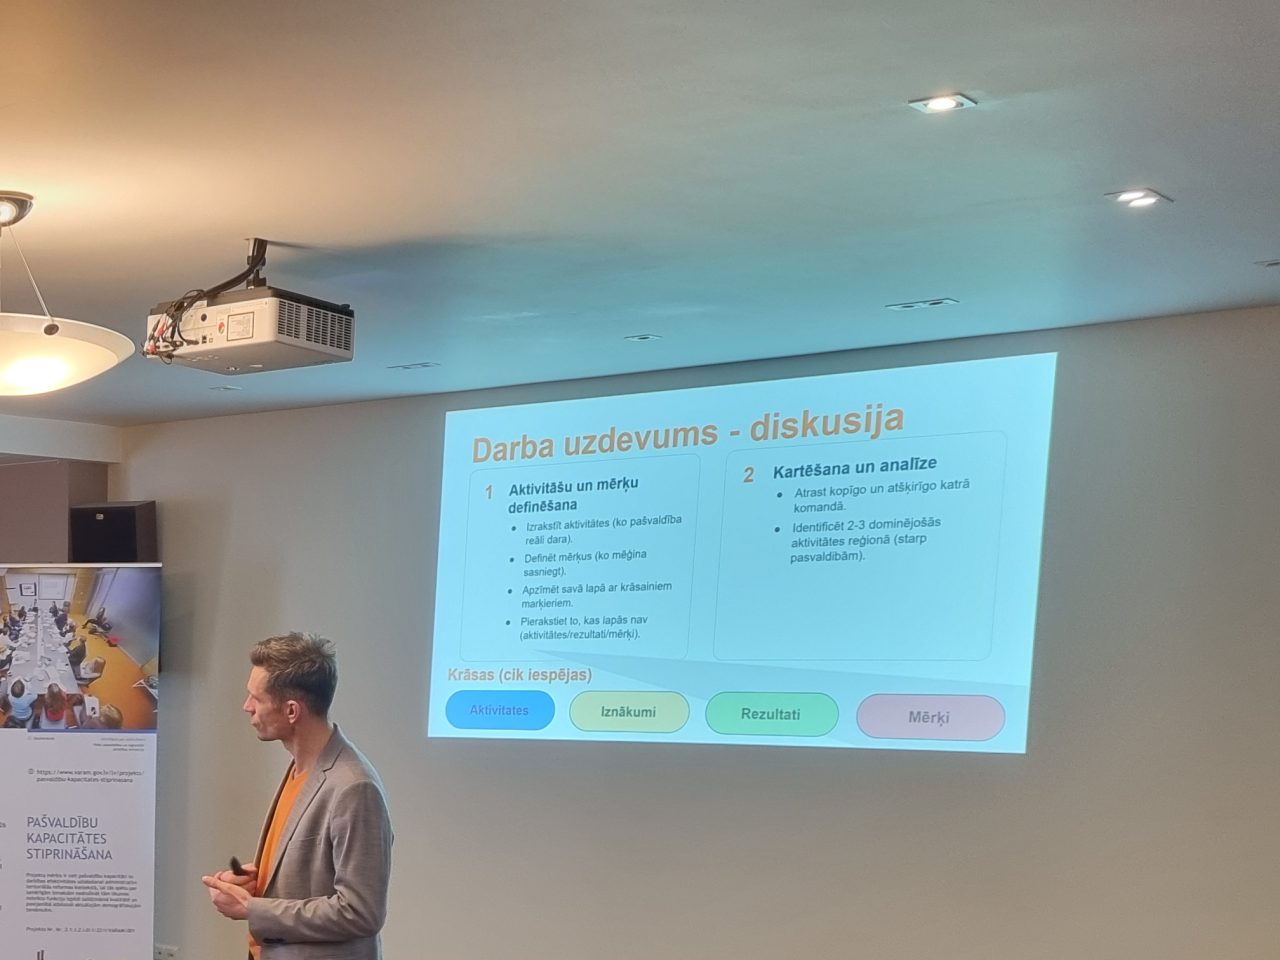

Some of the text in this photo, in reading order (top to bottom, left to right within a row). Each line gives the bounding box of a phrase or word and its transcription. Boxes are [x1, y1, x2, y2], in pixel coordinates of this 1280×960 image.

[472, 434, 554, 463] Darba
[564, 424, 718, 456] uzdevums
[750, 403, 904, 441] diskusija
[743, 467, 755, 483] 2
[773, 457, 938, 479] Kartēšana un analīze
[485, 484, 493, 499] 1
[508, 477, 639, 497] Aktivitāšu un mērķu
[794, 477, 970, 499] Atrast kopīgo un atšķirīgo katrā
[508, 499, 578, 514] definēšana
[793, 500, 847, 513] komandā.
[526, 513, 682, 532] Izrakstīt aktivitātes (ko pašvaldība
[792, 516, 942, 533] Identificēt 2-3 dominējošās
[525, 534, 573, 546] reāli dara).
[791, 533, 927, 548] aktivitātes reģionā (starp
[524, 549, 647, 565] Definēt mērķus (ko mēģina
[523, 566, 567, 578] sasniegt).
[522, 581, 673, 597] Apzīmēt savā lapā ar krāsainiem
[520, 615, 648, 628] Pierakstiet to, kas lapās nav
[448, 668, 592, 685] Krāsas (cik iespējas)
[601, 705, 656, 718] Iznākumi
[741, 708, 801, 721] Rezultati
[908, 710, 950, 727] Mērķi
[26, 814, 99, 828] PAŠVALDĪBU
[26, 831, 107, 844] KAPACITĀTES
[26, 846, 113, 860] STIPRINĀŠANA
